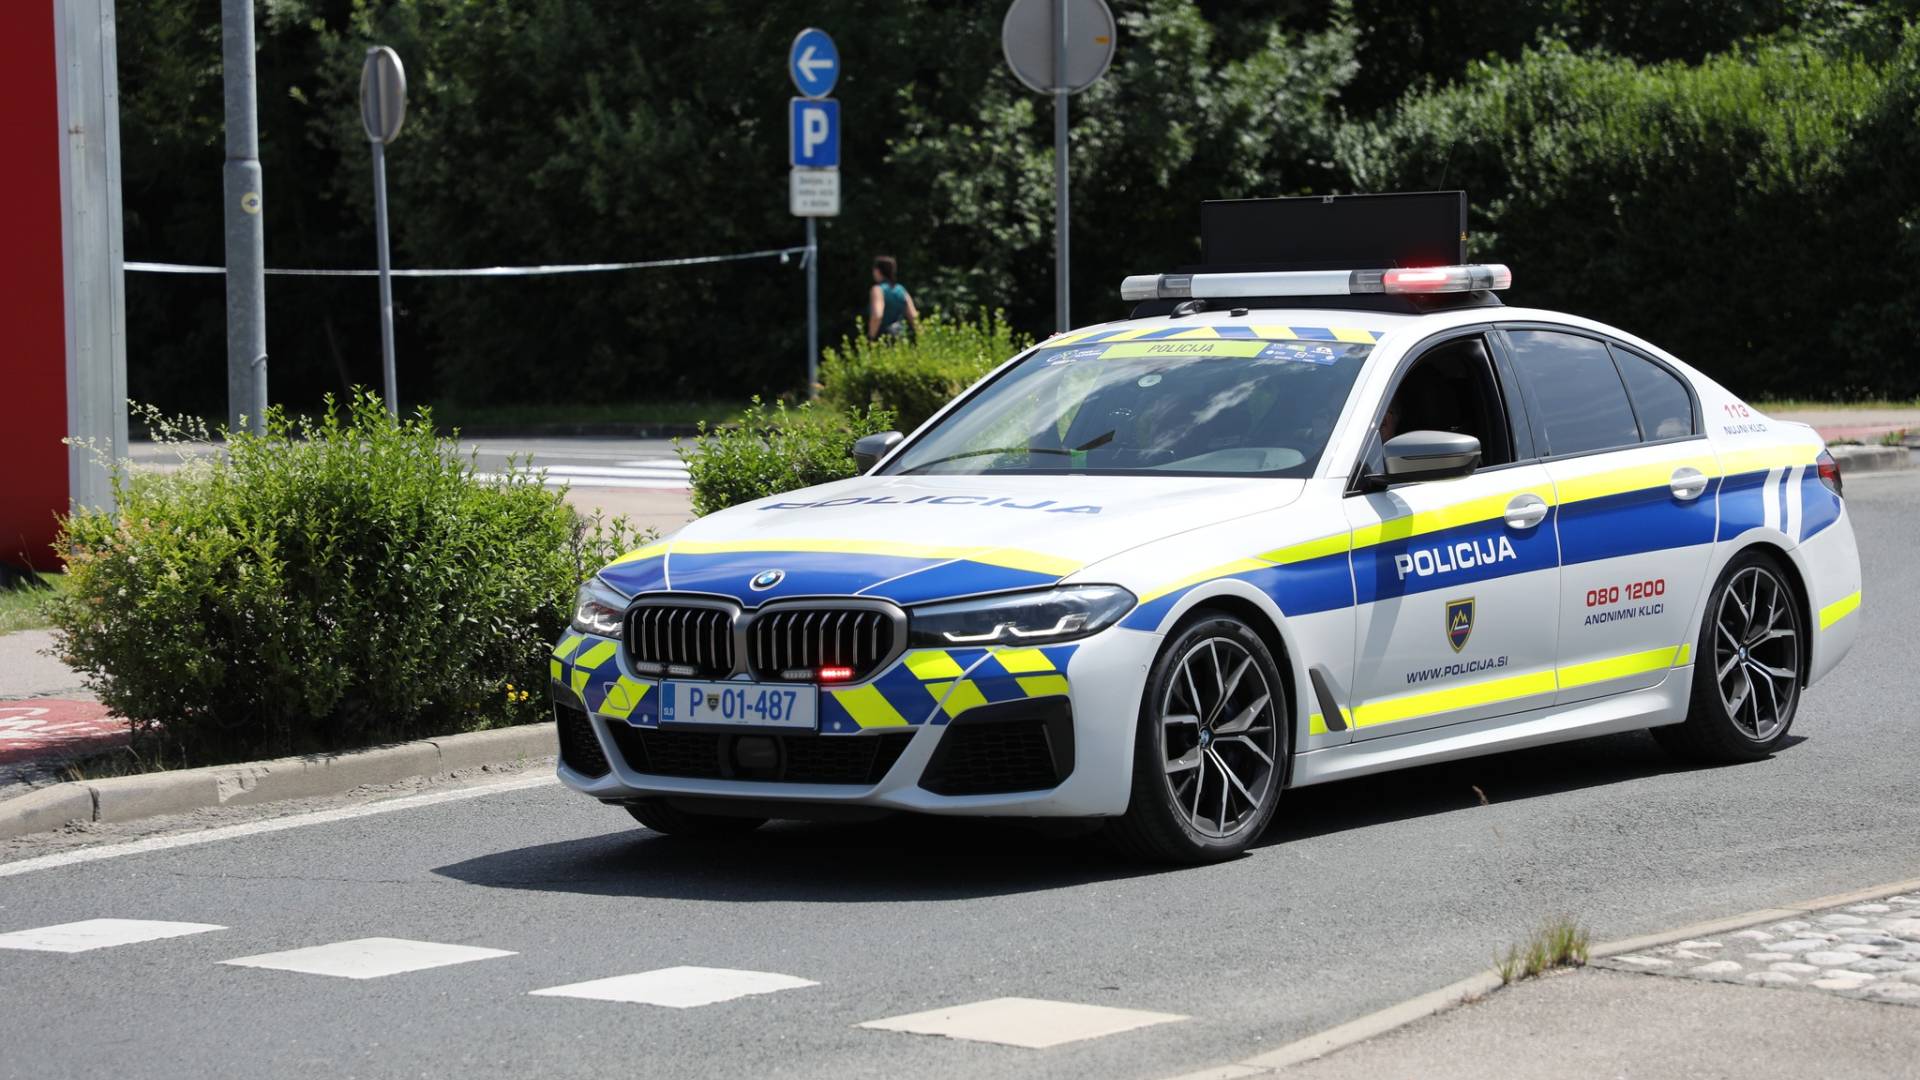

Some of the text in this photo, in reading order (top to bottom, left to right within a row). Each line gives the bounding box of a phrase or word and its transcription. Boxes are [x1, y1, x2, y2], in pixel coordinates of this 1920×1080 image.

[803, 108, 829, 158] P
[1146, 343, 1215, 353] POLICIJA
[1724, 403, 1749, 418] 113
[757, 495, 1104, 514] POLICIJA
[1394, 535, 1517, 581] POLICIJA
[1586, 578, 1665, 607] 080 1200
[1584, 603, 1665, 626] ANONIMNI KLICI
[1406, 655, 1509, 684] WWW.POLICIJA.SI
[689, 687, 797, 721] P 01-487
